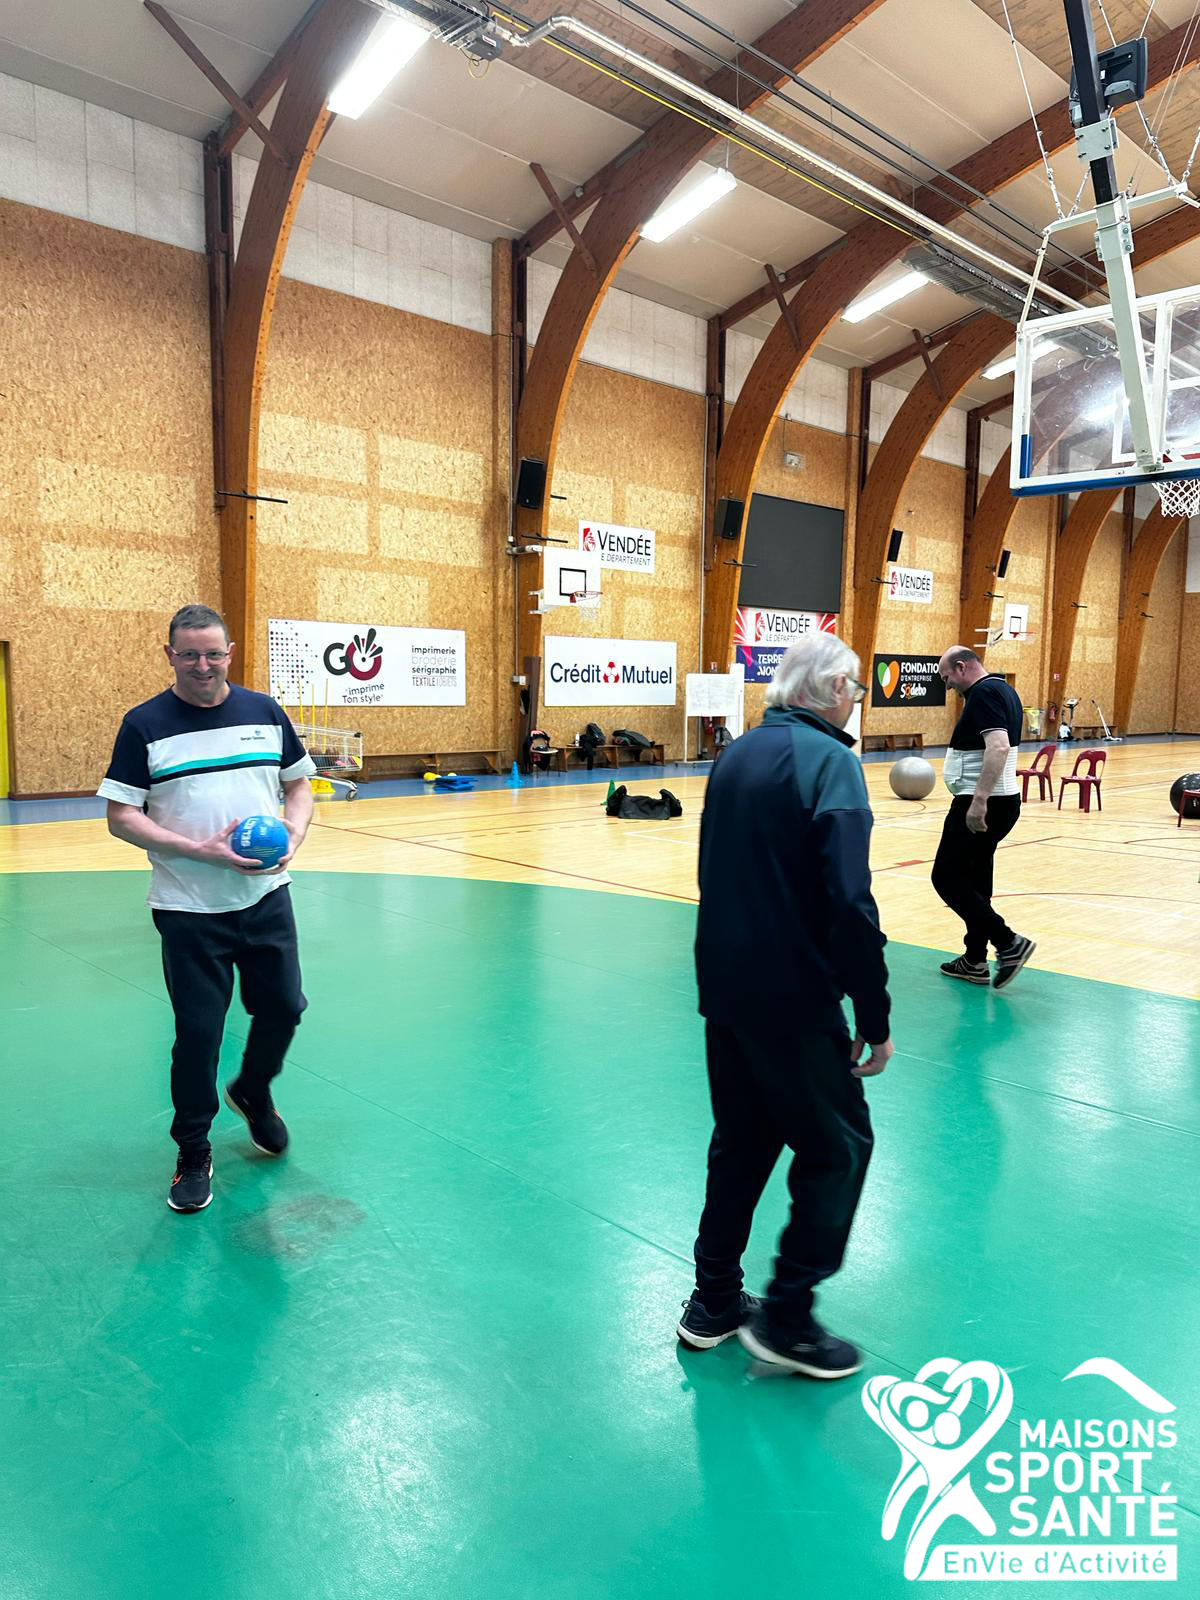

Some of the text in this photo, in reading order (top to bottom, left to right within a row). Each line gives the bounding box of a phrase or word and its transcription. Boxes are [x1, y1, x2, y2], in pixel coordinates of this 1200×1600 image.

[597, 529, 651, 556] VENDÉE
[900, 573, 931, 591] VENDÉE
[411, 644, 456, 655] imprimerie
[411, 655, 457, 666] broderie
[411, 665, 457, 676] sérigraphie
[550, 662, 672, 684] Crédit Mutuel
[901, 662, 940, 674] FONDATIO
[342, 694, 358, 704] Ton
